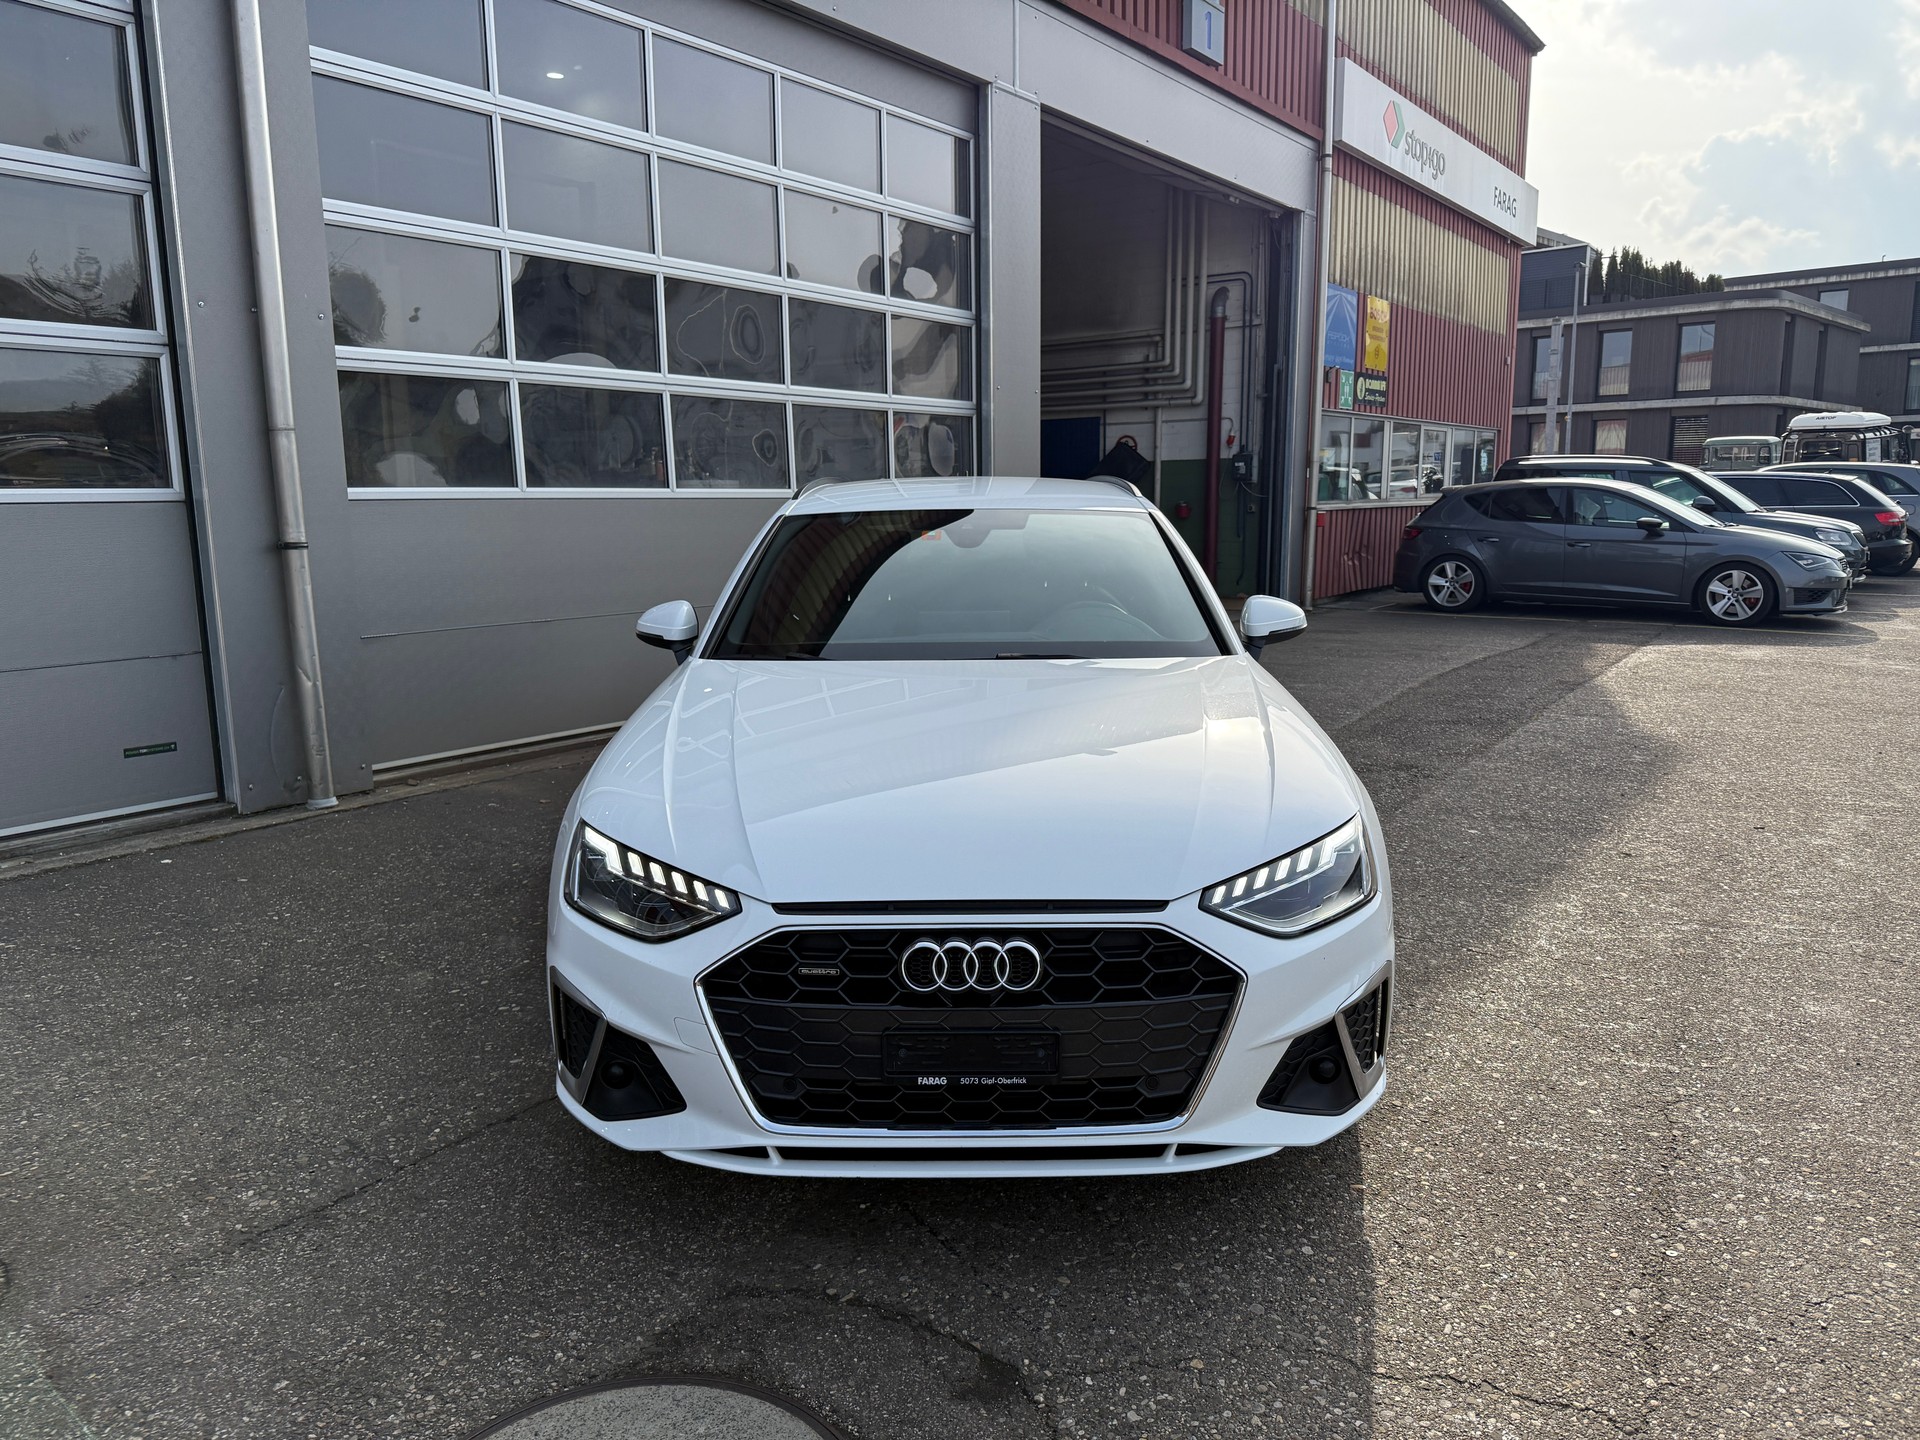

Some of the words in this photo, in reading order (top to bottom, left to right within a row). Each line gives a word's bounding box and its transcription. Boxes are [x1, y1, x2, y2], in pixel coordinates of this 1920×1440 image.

[1204, 11, 1212, 50] 1
[1493, 186, 1517, 218] FARAG
[917, 1077, 947, 1085] FARAG
[980, 1077, 1027, 1085] Gipf-Oberfrick
